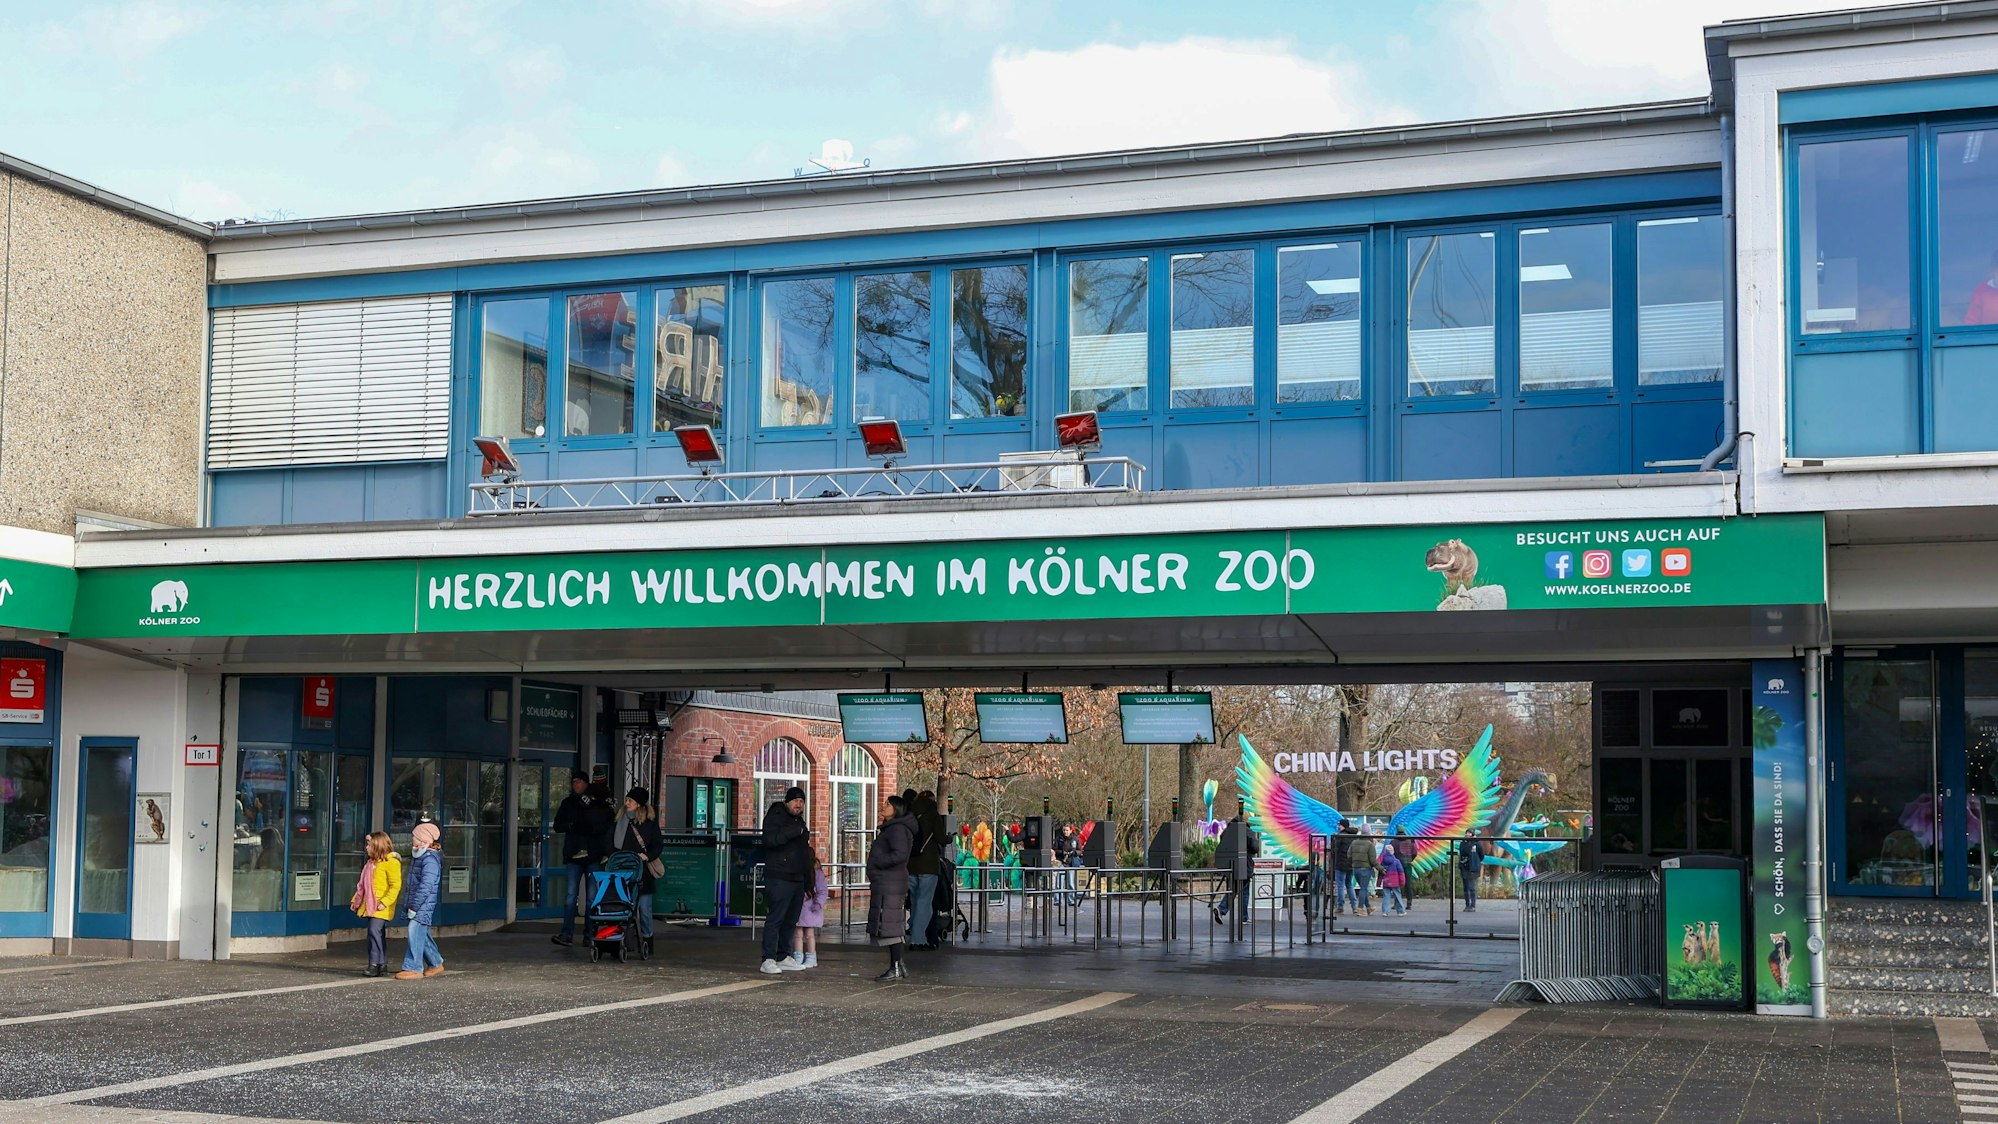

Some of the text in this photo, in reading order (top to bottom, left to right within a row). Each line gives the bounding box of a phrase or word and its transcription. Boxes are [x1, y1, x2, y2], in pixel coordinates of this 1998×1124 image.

[1516, 527, 1721, 545] BESUCHT UNS AUCH AUF
[428, 546, 1316, 611] HERZLICH WILLKOMMEN IM KÖLNER ZOO
[1544, 582, 1692, 596] WWW.KOELNERZOO.DE
[138, 616, 201, 626] KÖLNER ZOO
[1160, 695, 1192, 704] AQUARIUM
[193, 749, 205, 759] Tor
[1273, 748, 1458, 773] CHINA LIGHTS
[1773, 762, 1785, 897] SCHÖN, DASS SIE DA SIND!
